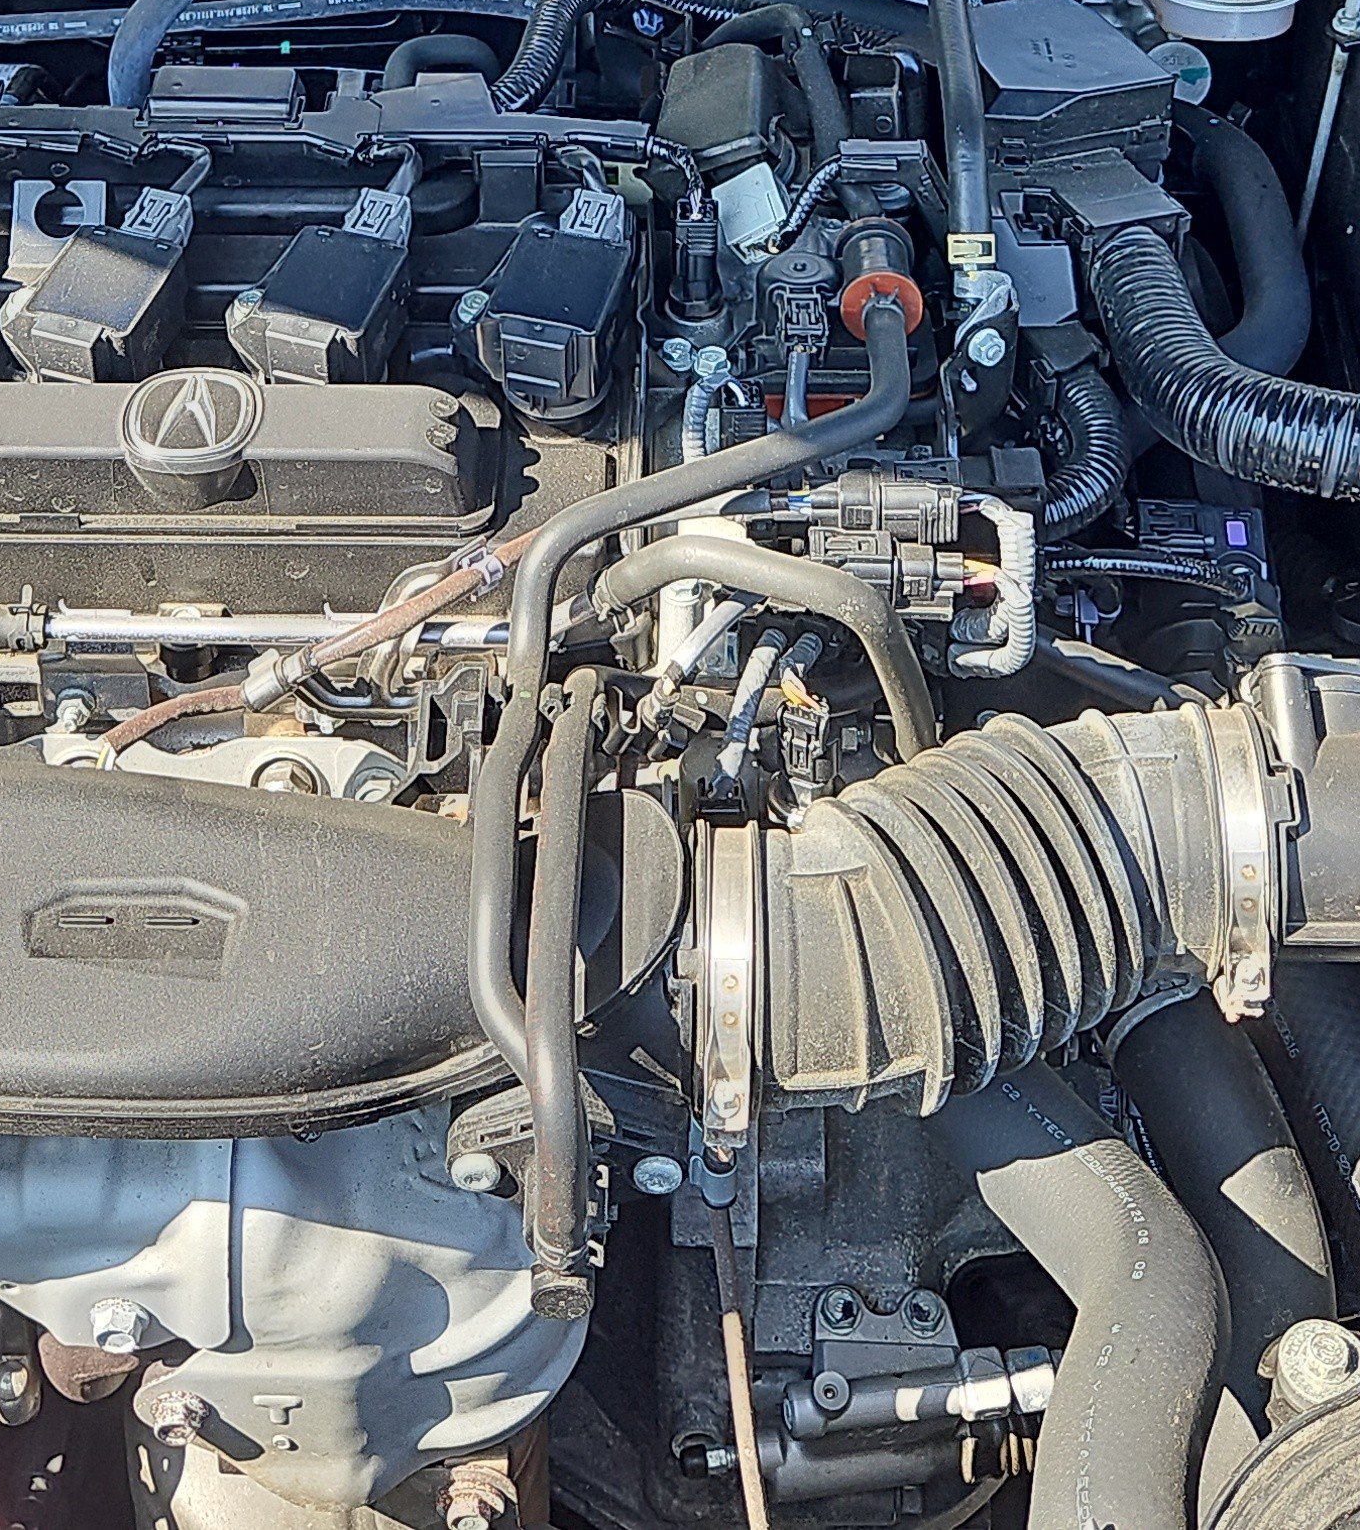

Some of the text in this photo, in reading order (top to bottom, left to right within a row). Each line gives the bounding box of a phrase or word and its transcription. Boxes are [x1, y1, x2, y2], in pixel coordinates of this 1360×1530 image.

[1001, 1082, 1021, 1101] C2
[1026, 1103, 1067, 1140] Y-TEC
[1130, 1260, 1147, 1280] 09
[1096, 1344, 1113, 1367] C2
